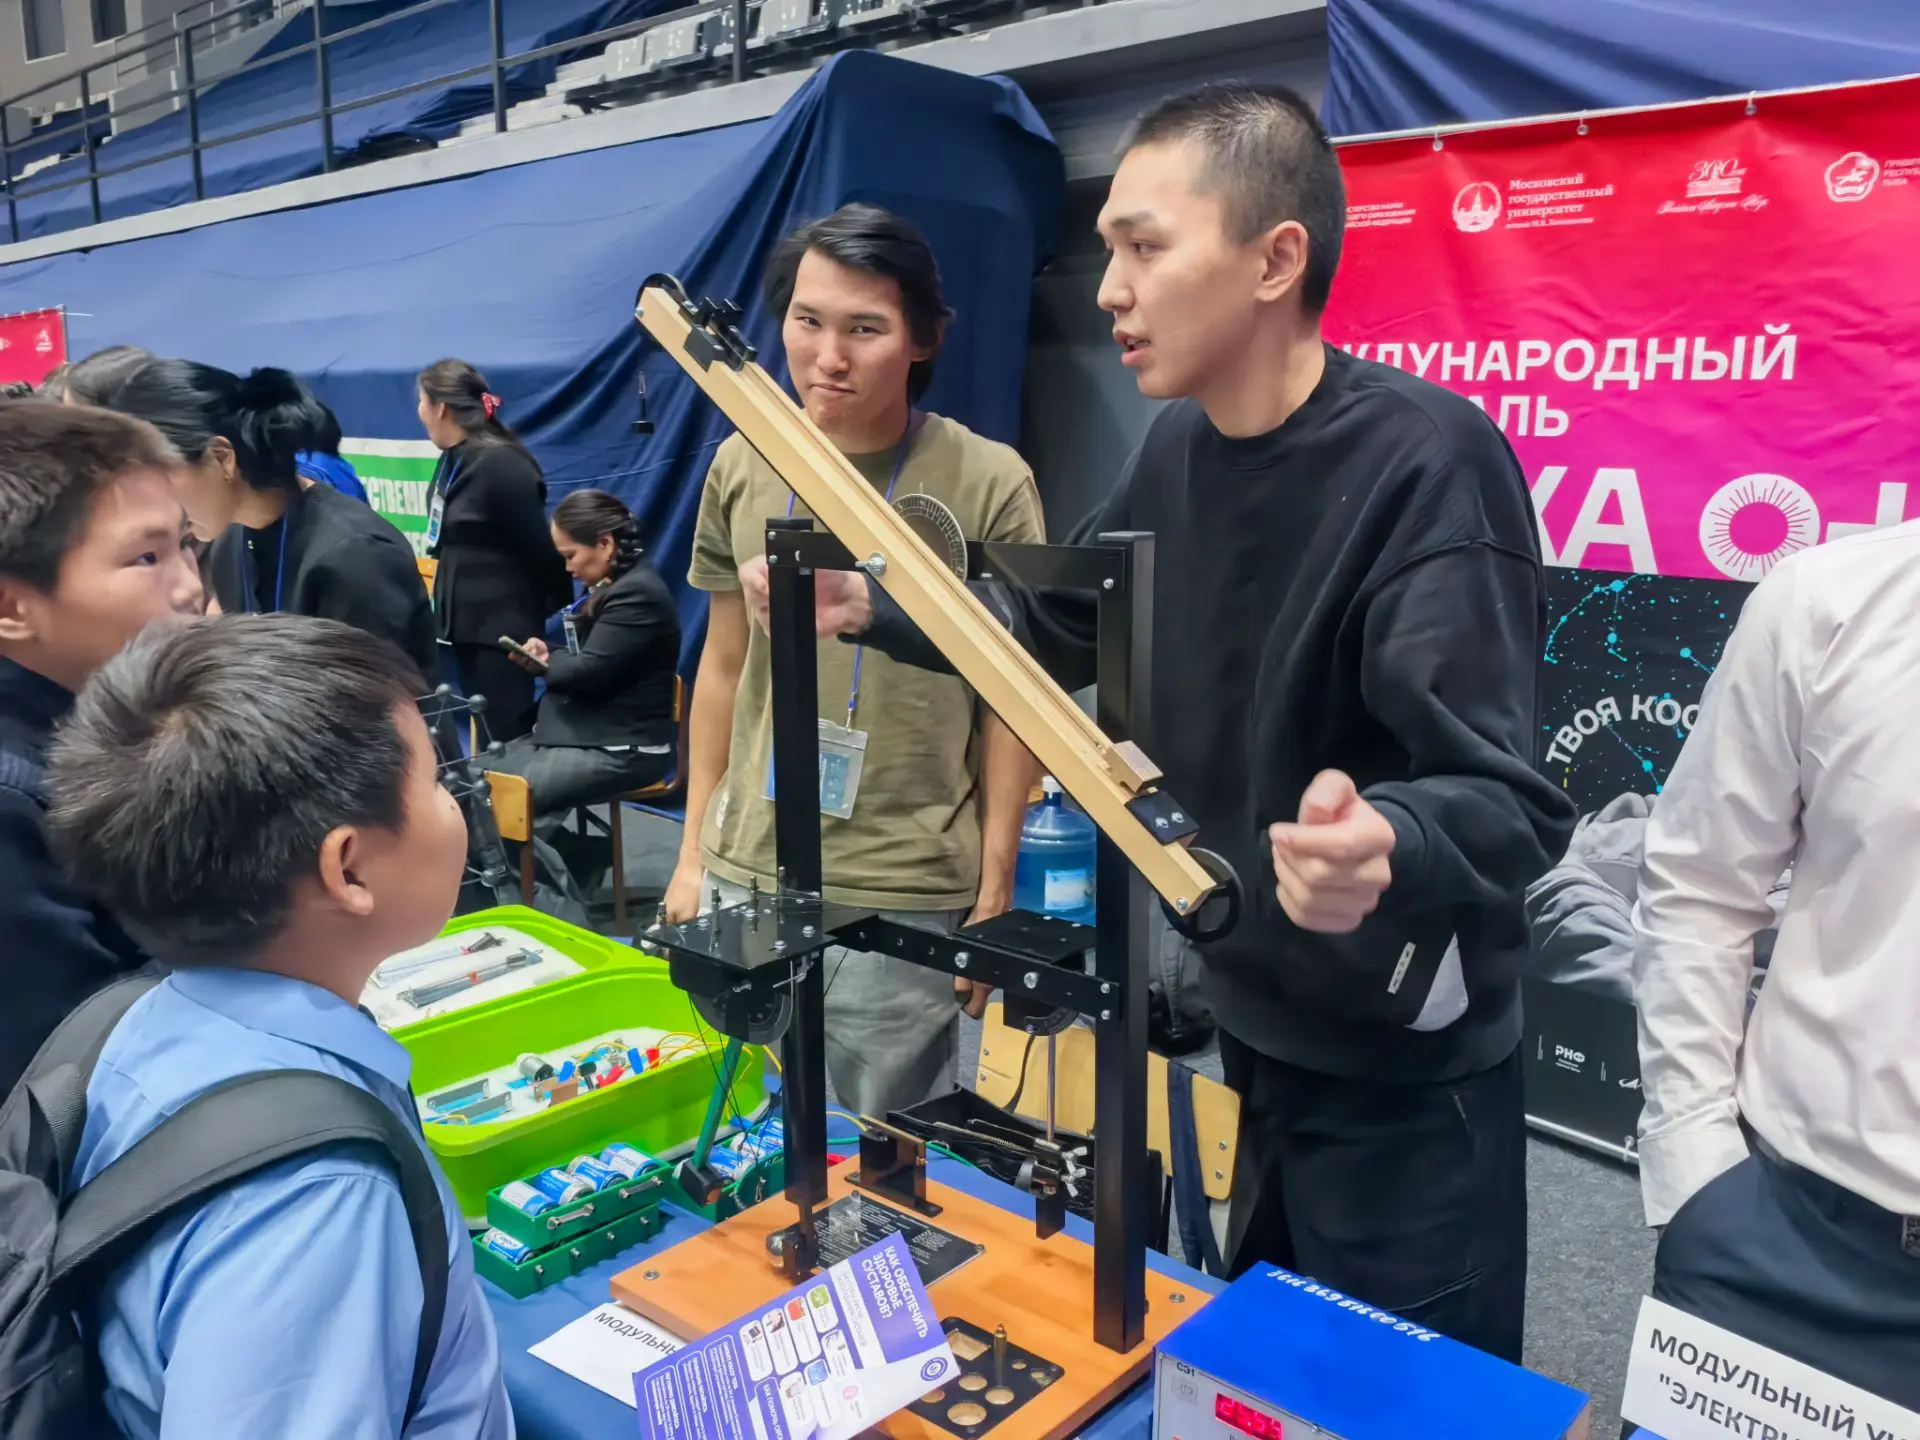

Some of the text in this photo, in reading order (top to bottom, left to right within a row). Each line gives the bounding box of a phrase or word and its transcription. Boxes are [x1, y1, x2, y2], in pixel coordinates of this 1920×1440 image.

[1508, 184, 1614, 204] государственный
[1509, 173, 1585, 191] Московский
[1506, 203, 1585, 220] университет
[1545, 695, 1622, 764] ТВОЯ
[1554, 1044, 1586, 1063] РНФ
[860, 1258, 892, 1319] СУСТАВОВ?
[871, 1251, 903, 1309] ЗДОРОВЬЕ
[883, 1244, 901, 1268] КАК
[892, 1266, 930, 1338] ОБЕСПЕЧИТЬ
[1650, 1328, 1856, 1440] МОДУЛЬНЫЙ
